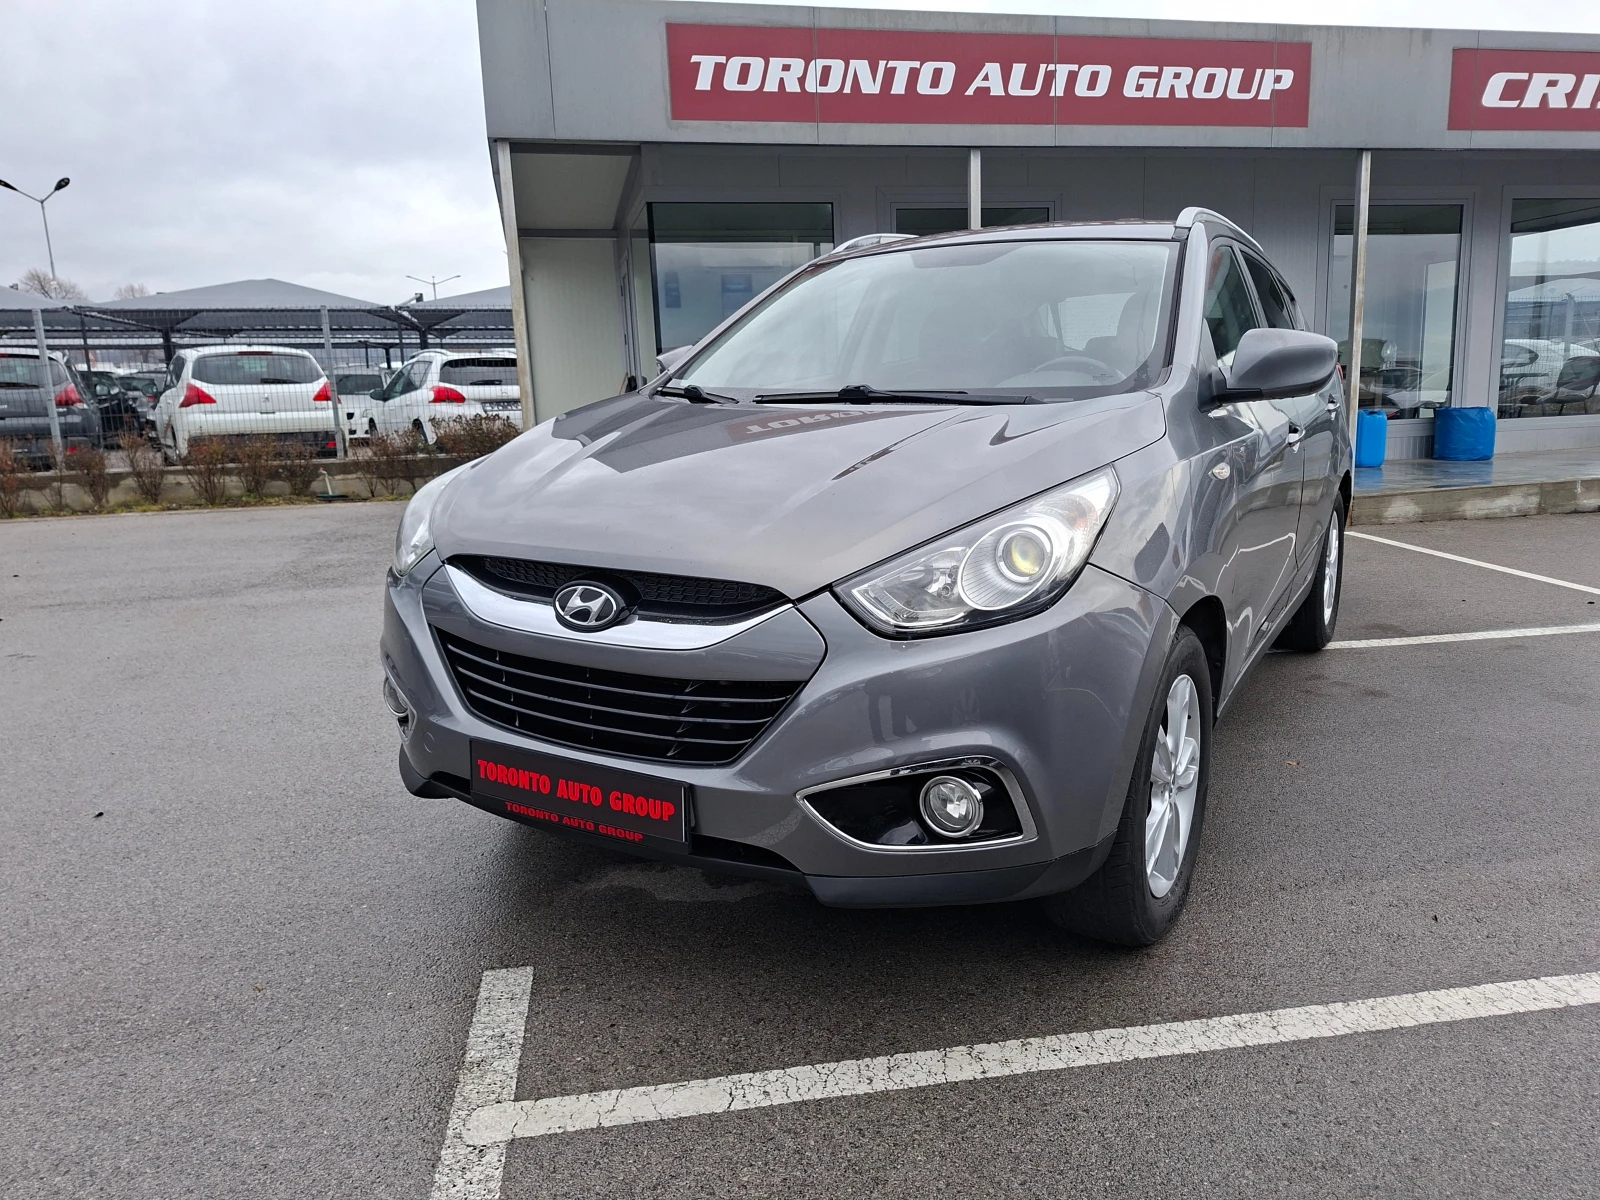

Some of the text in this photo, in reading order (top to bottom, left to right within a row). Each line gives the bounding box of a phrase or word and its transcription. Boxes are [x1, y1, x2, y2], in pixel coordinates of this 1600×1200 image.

[690, 54, 1295, 100] TORONTO AUTO GROUP
[1481, 72, 1600, 109] CRI
[477, 759, 675, 821] TORONTO AUTO GROUP
[505, 801, 643, 841] TORONTO AUTO GROUP
